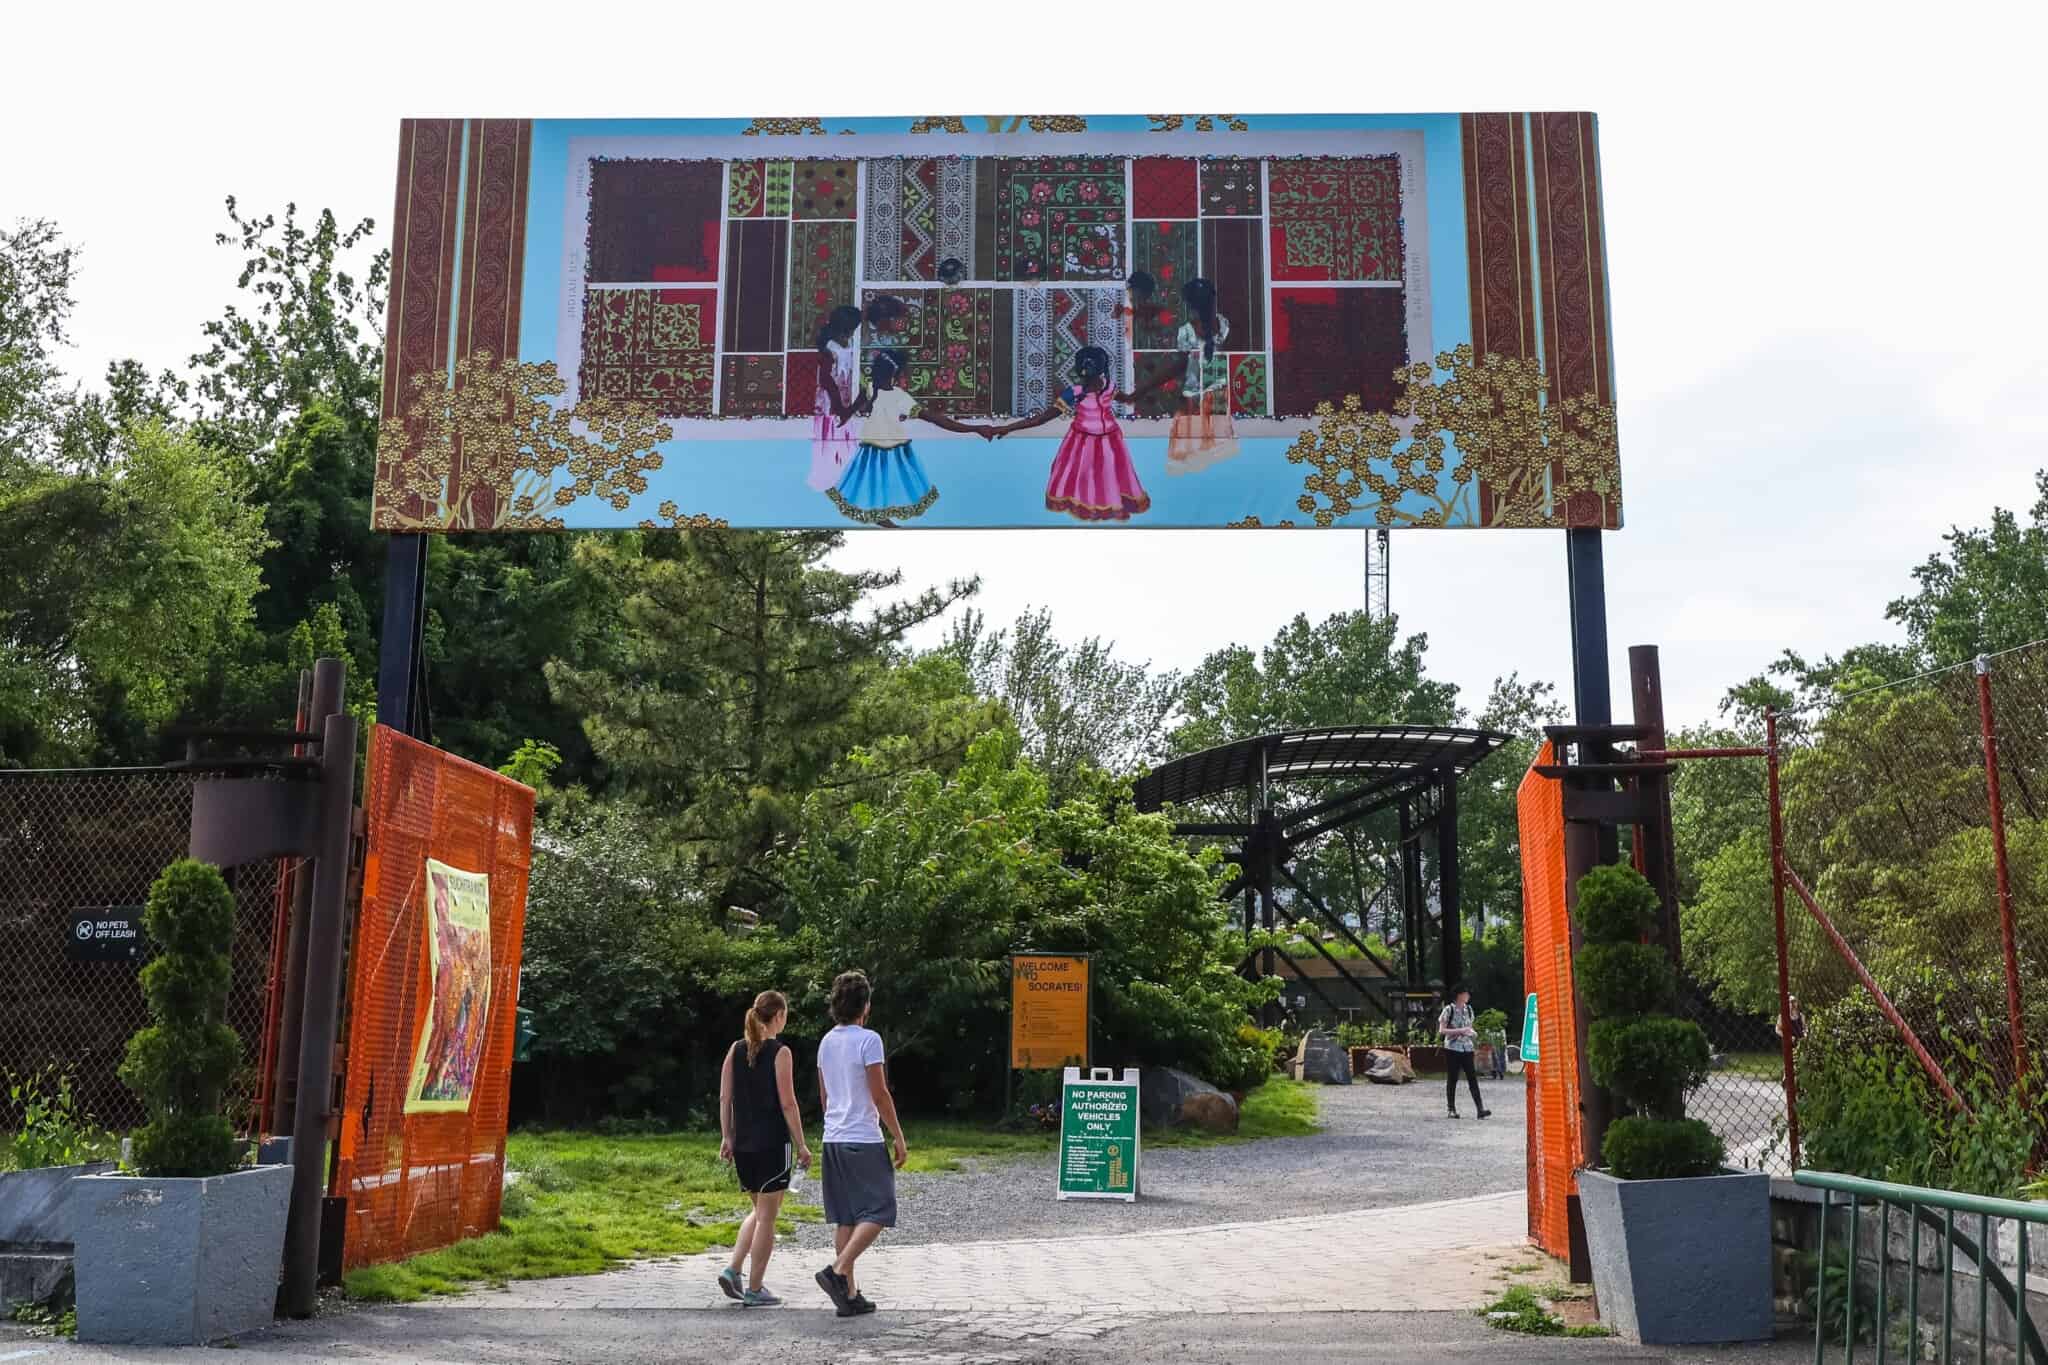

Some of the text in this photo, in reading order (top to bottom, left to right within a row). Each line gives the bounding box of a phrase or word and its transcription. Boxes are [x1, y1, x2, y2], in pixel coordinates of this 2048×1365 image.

[97, 921, 129, 929] NO PETS
[96, 930, 136, 938] OFF LEASH
[1018, 961, 1069, 972] WELCOME
[1028, 982, 1083, 992] SOCRATES!
[1072, 1090, 1127, 1100] NO PARKING
[1071, 1101, 1128, 1111] AUTHORIZED
[1078, 1112, 1121, 1121] VEHICLES
[1087, 1122, 1112, 1131] ONLY
